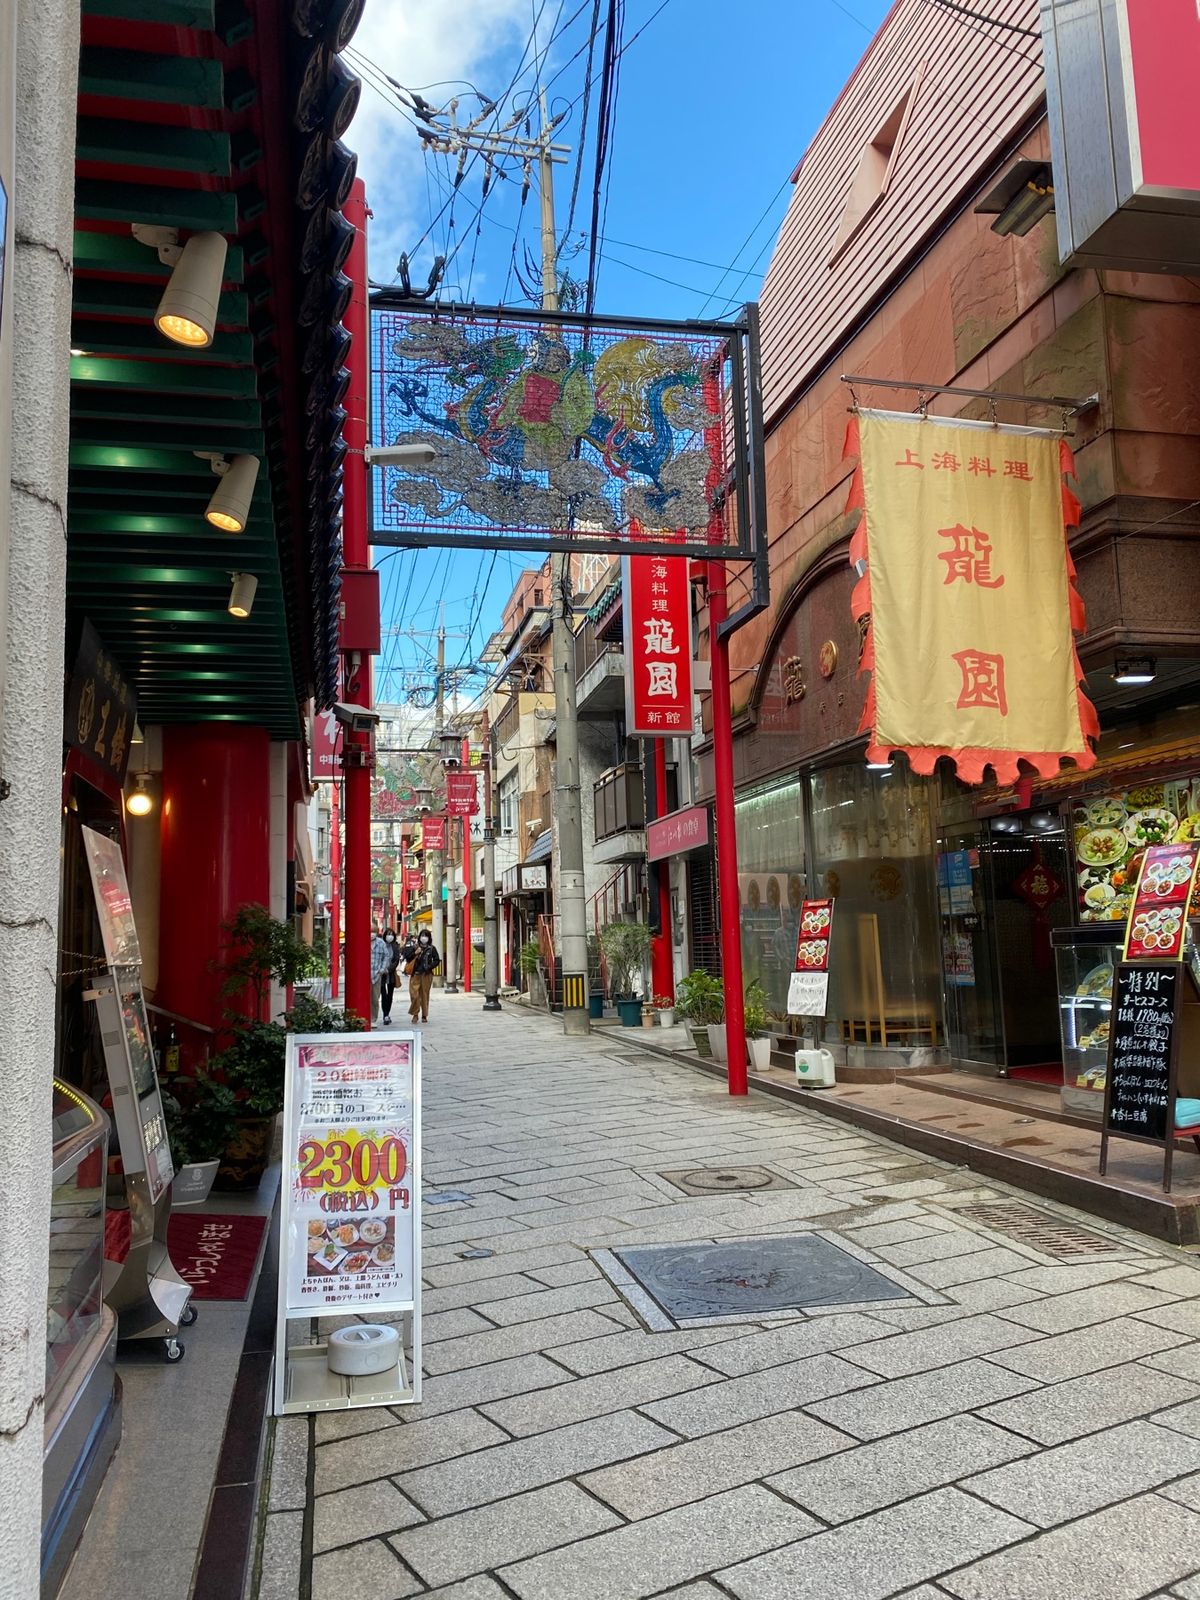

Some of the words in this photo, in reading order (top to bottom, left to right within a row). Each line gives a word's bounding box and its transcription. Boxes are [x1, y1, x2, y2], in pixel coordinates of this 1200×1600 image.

[895, 448, 1034, 482] 上海料理
[937, 523, 1008, 716] 龍園
[643, 616, 680, 700] 龍園
[646, 711, 681, 724] 新館
[1123, 994, 1168, 1007] サービスコース
[297, 1138, 406, 1188] 2300
[319, 1191, 379, 1212] (税込)
[389, 1189, 410, 1211] 円
